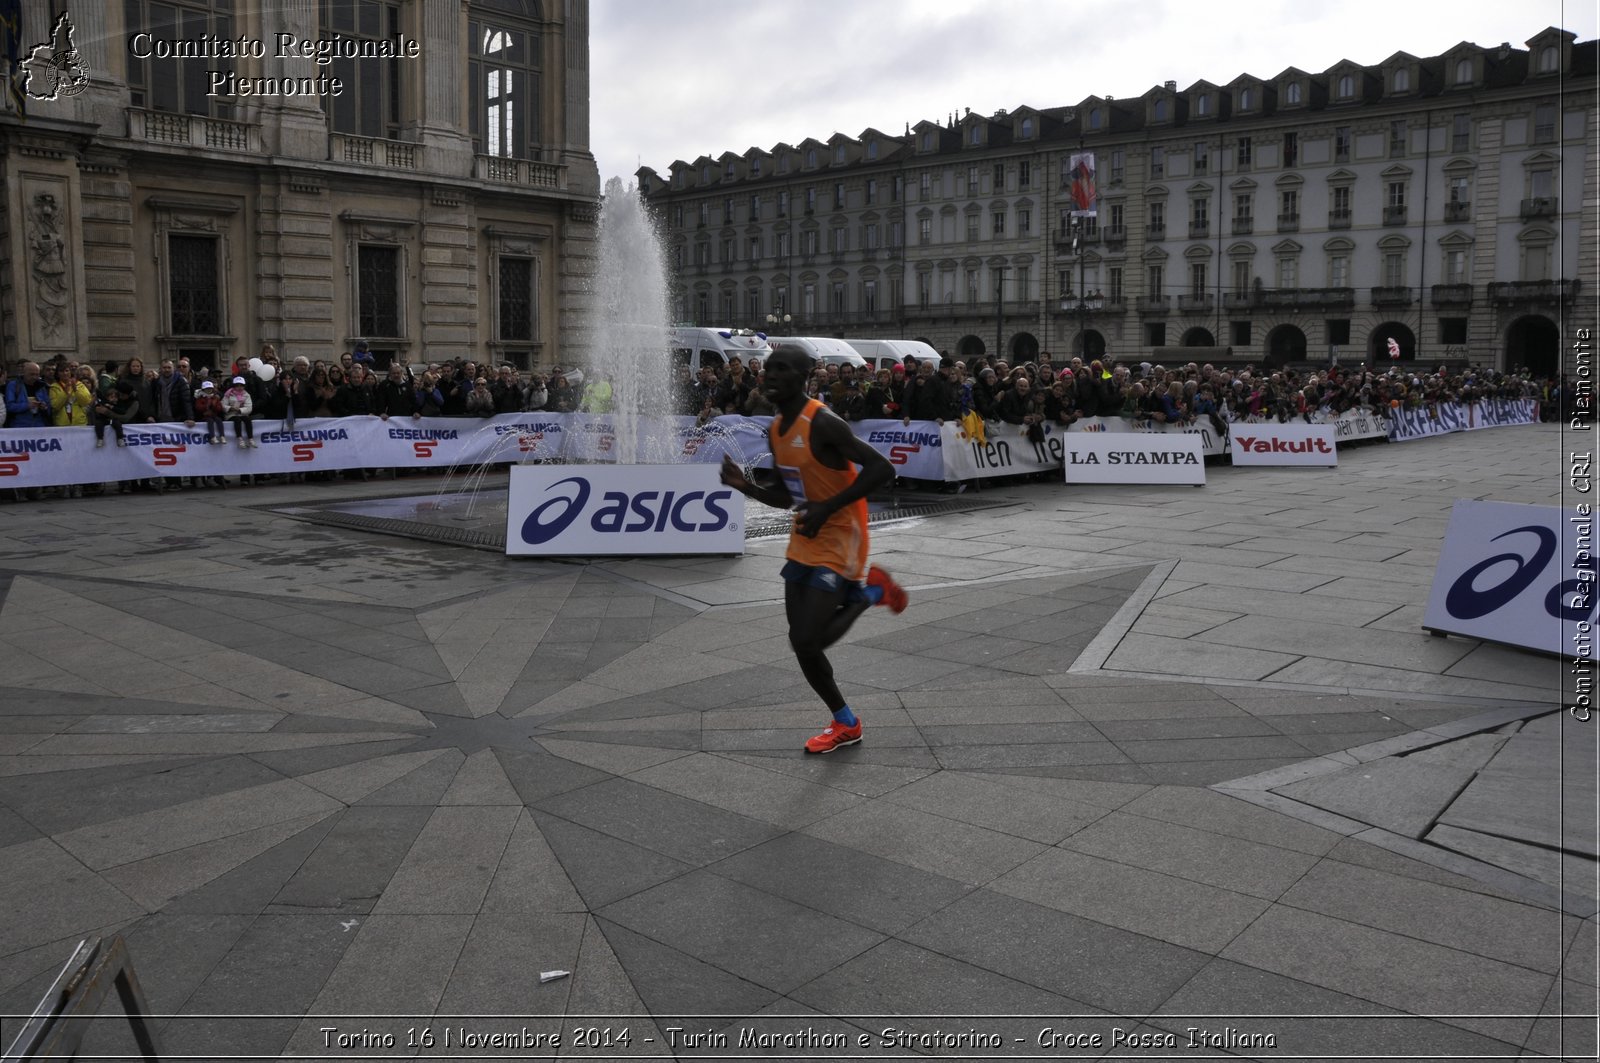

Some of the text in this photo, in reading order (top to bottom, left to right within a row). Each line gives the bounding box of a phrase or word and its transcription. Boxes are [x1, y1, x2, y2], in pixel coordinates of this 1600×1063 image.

[122, 432, 213, 447] ESSELUNGA
[260, 428, 350, 443] ESSELUNGA
[388, 428, 458, 440] ESSELUNGA
[868, 431, 943, 447] ESSELUNG
[0, 437, 63, 454] LUNGA
[1032, 437, 1065, 463] ire
[1235, 437, 1333, 453] Yakult
[1069, 451, 1200, 465] LA STAMPA
